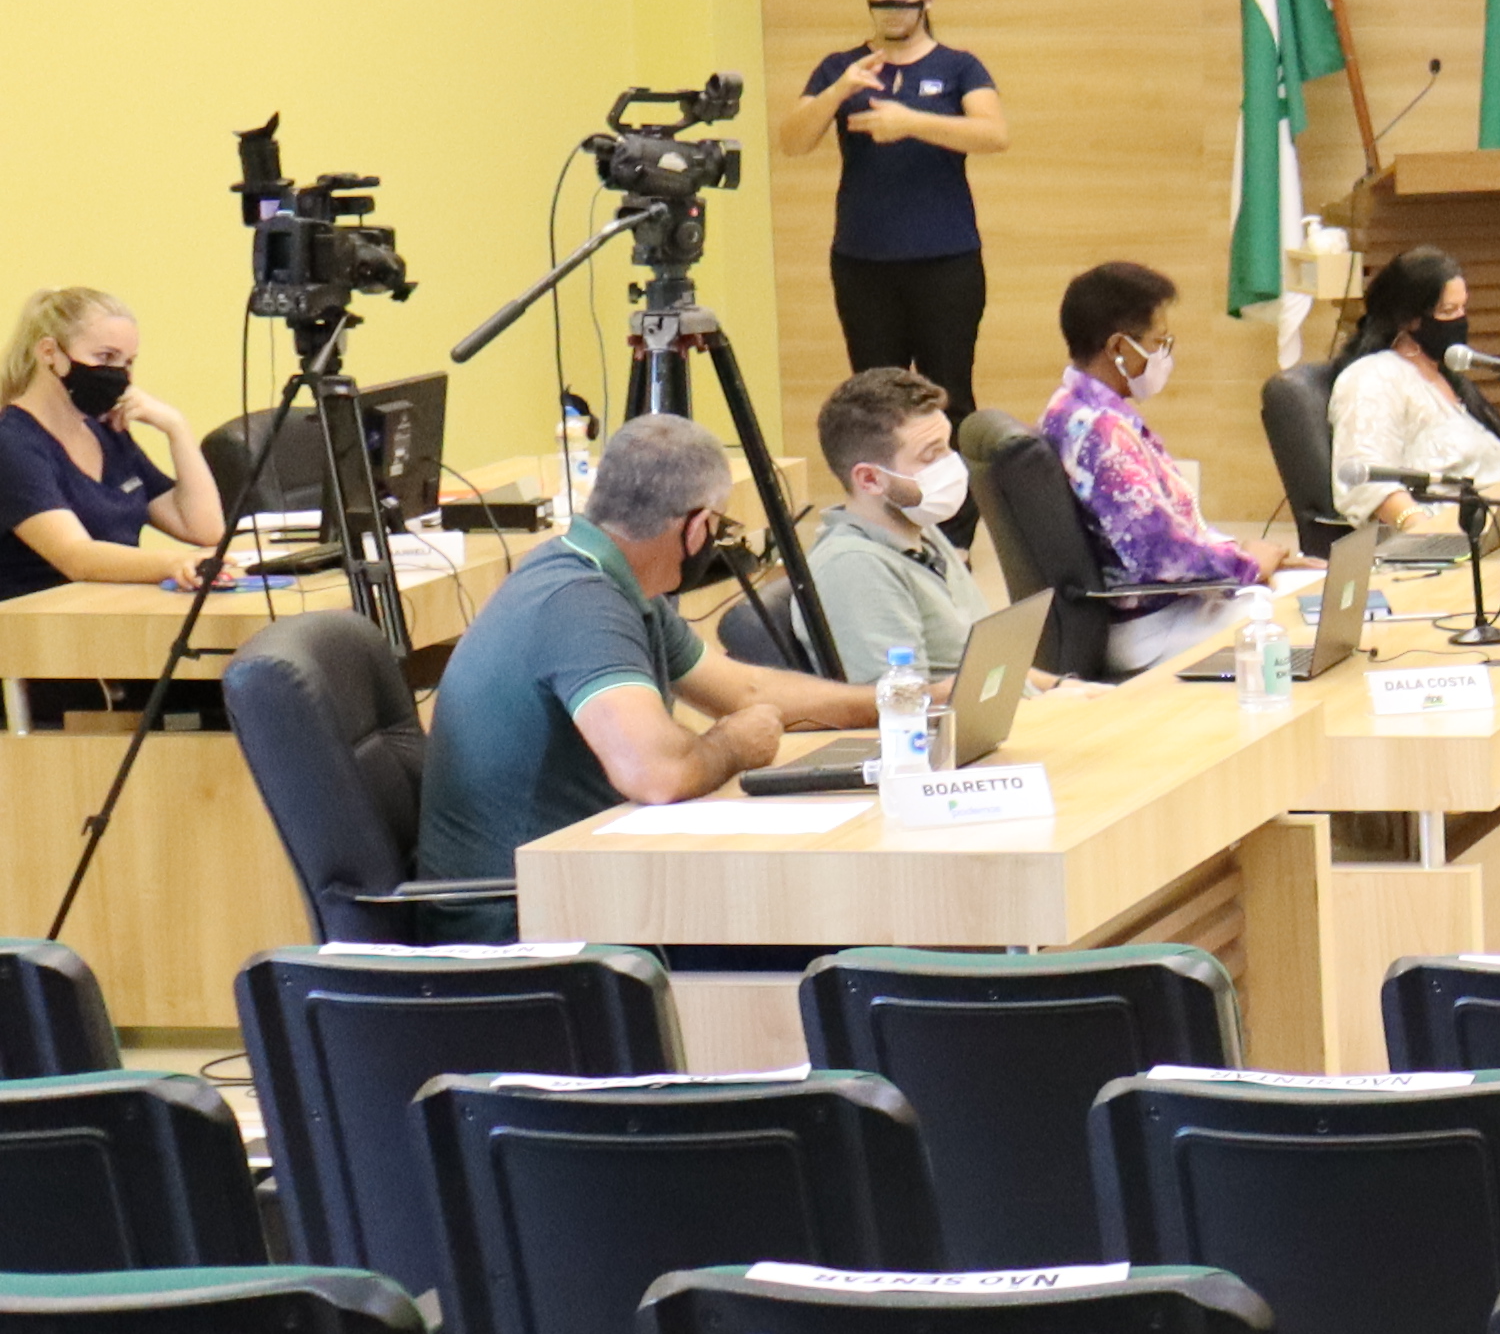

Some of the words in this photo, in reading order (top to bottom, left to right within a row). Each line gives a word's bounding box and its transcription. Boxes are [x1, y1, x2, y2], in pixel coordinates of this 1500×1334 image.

[1385, 679, 1424, 691] DALA
[1428, 676, 1476, 688] COSTA
[922, 777, 1024, 797] BOARETTO
[815, 1274, 956, 1286] SENTAR
